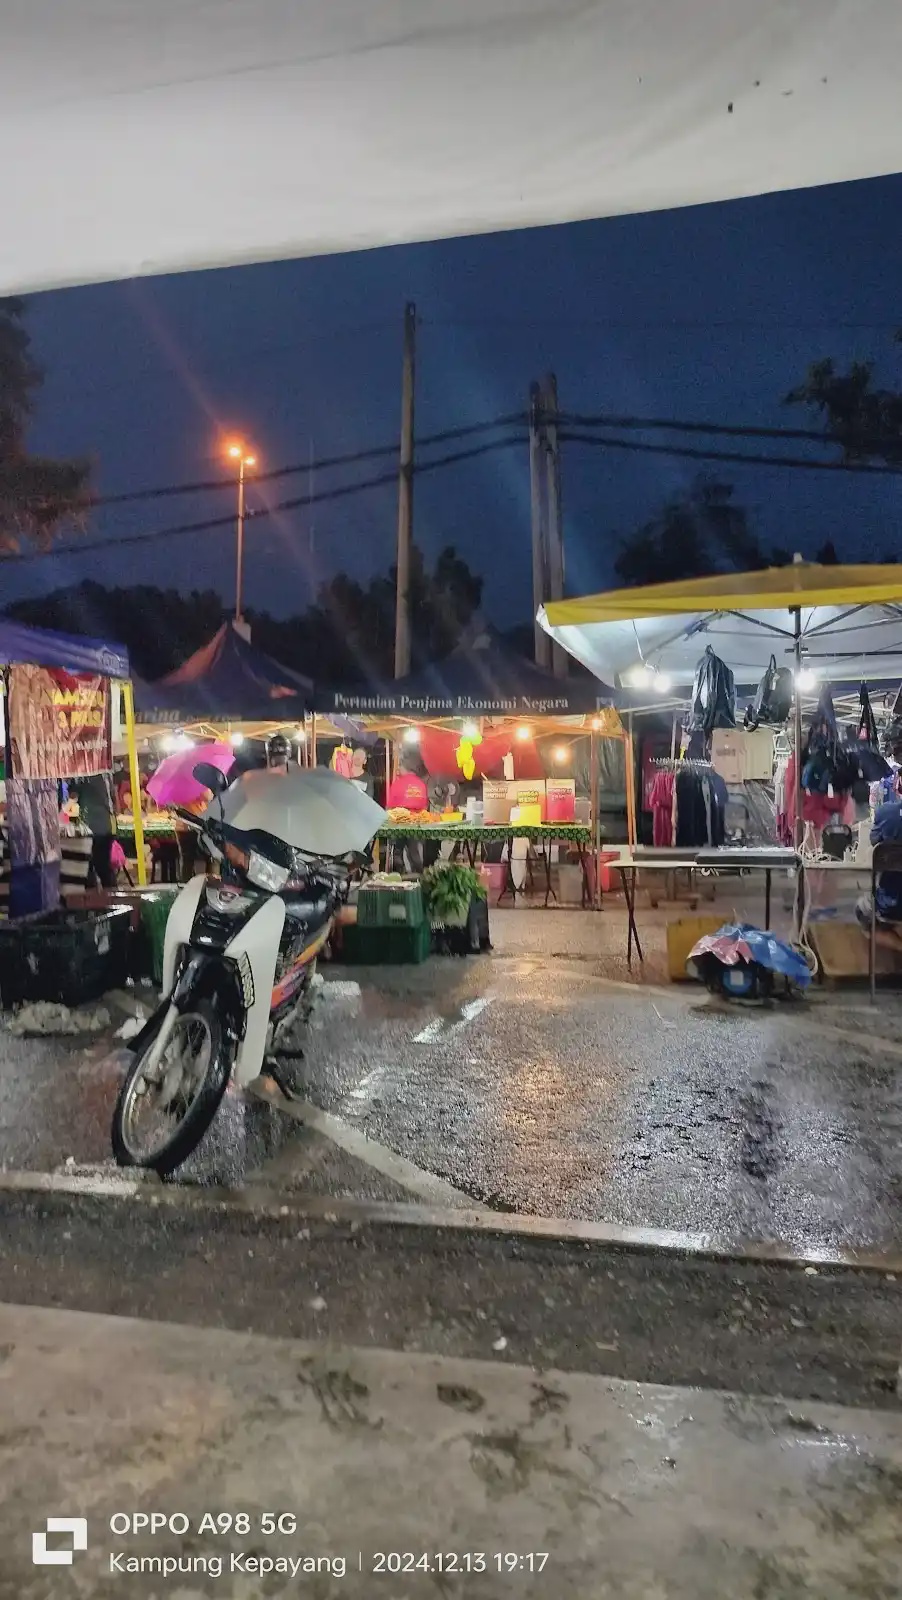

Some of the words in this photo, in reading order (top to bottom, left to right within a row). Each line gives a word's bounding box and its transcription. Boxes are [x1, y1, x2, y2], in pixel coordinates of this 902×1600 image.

[334, 693, 396, 709] Pertanian
[400, 694, 453, 712] Penjana
[457, 695, 517, 709] Ekonomi
[521, 696, 569, 712] Negara
